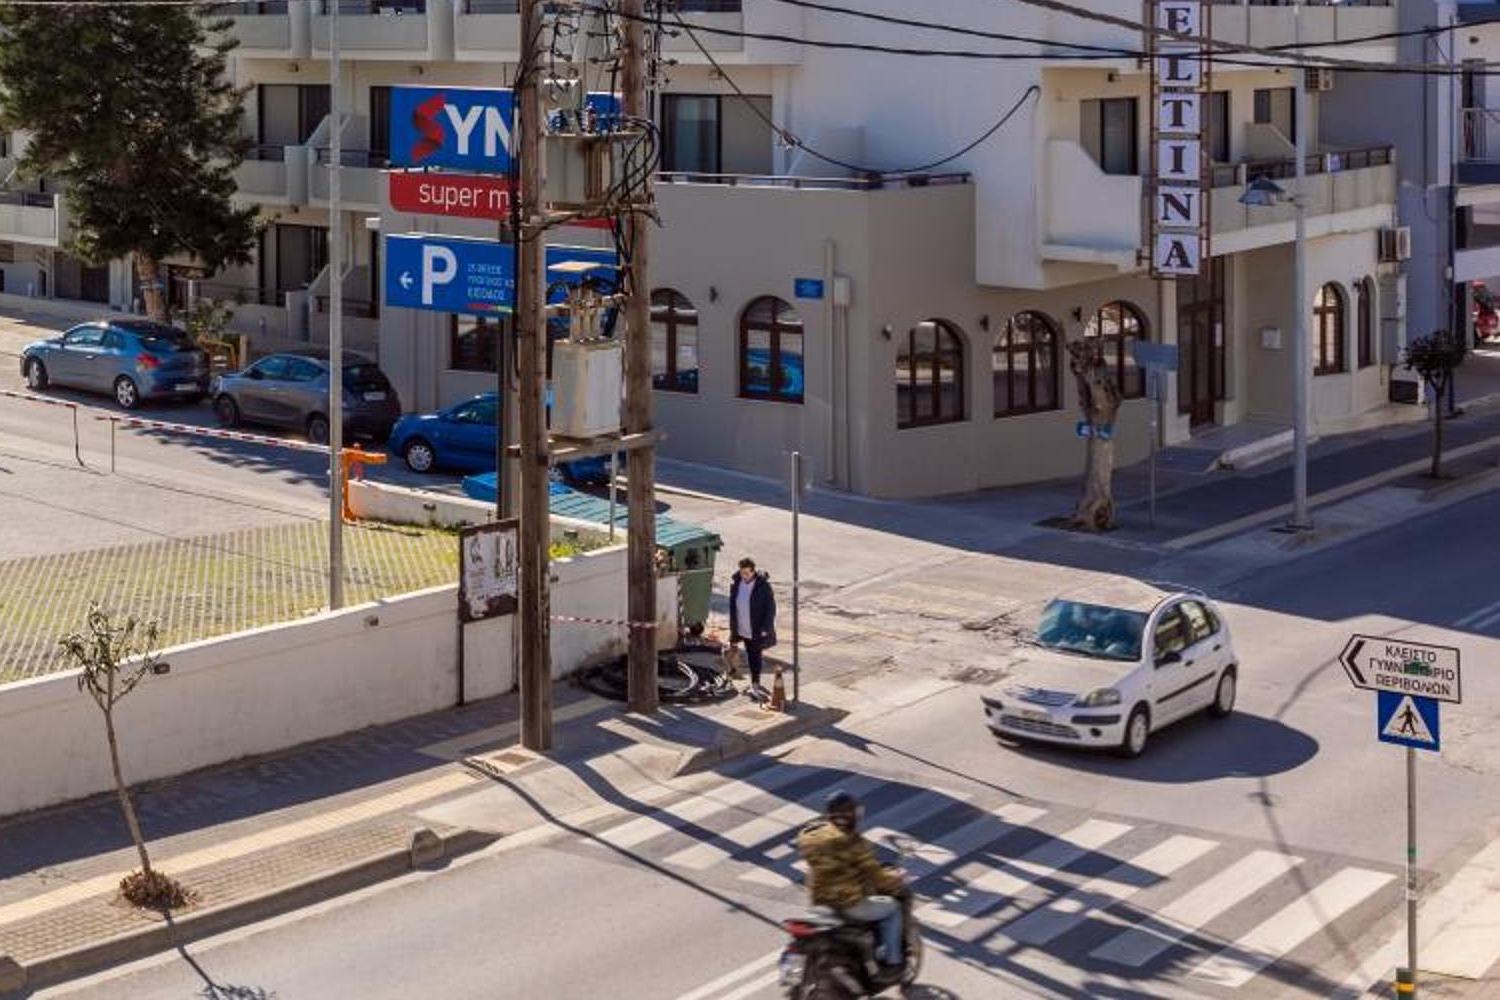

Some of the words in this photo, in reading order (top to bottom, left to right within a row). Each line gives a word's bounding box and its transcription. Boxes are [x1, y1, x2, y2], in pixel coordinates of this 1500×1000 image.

[1161, 7, 1194, 269] ELTINA
[419, 183, 483, 211] super
[421, 245, 458, 305] P
